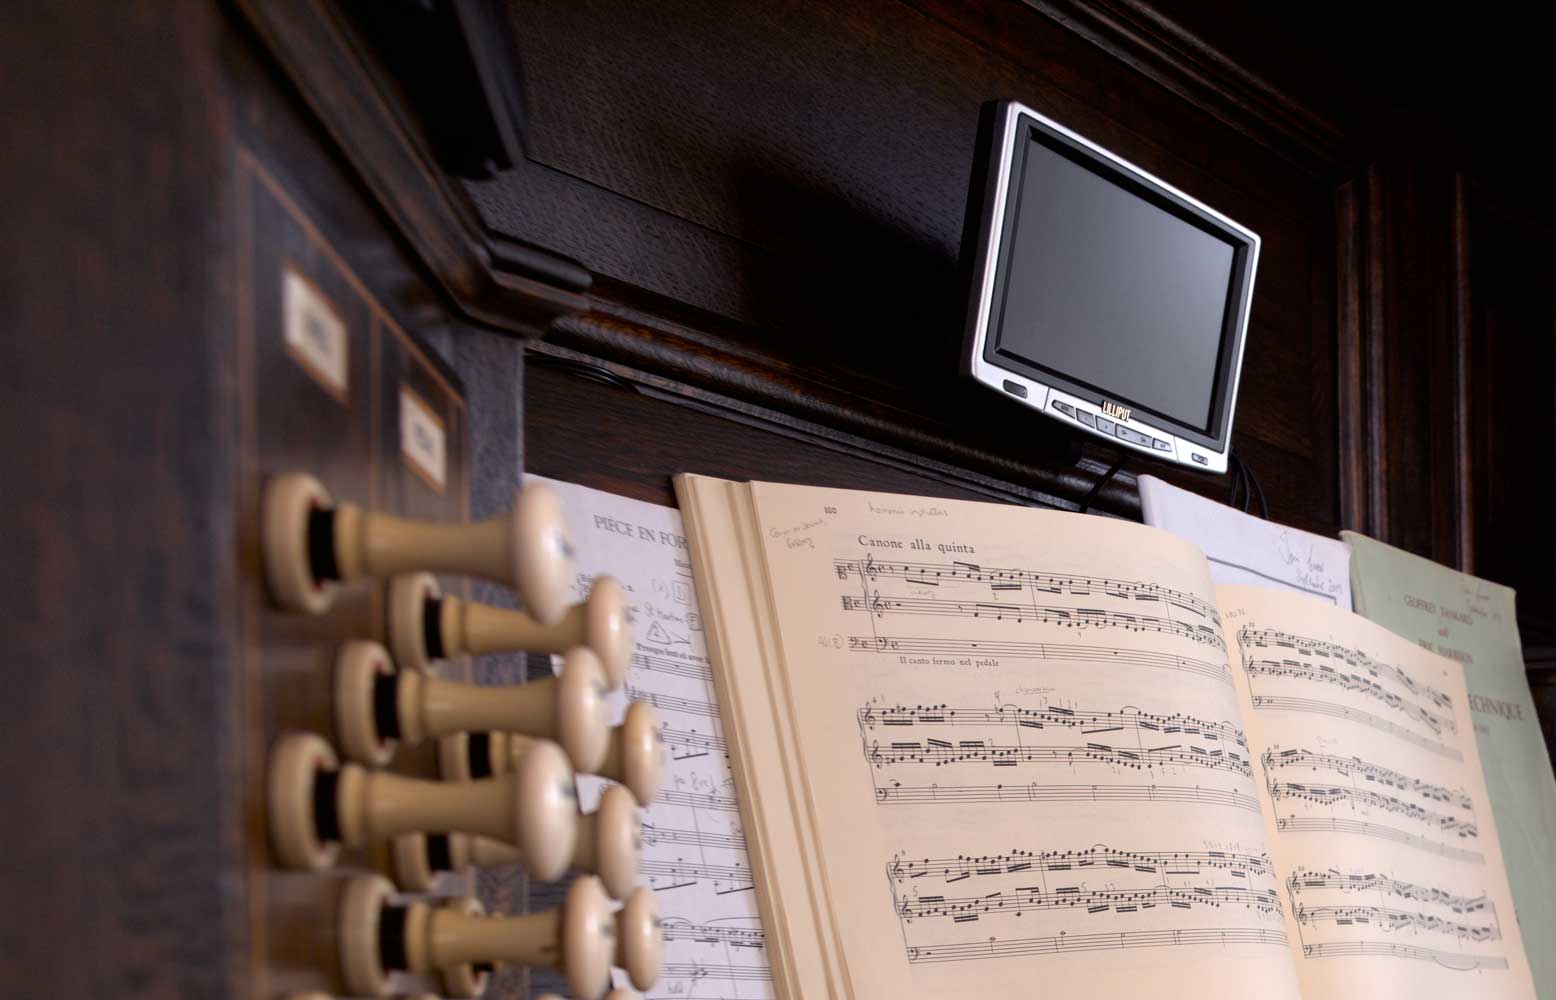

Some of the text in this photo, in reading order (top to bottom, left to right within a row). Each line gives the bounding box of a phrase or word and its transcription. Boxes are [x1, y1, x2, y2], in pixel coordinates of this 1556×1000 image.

[1102, 401, 1131, 422] LILLIPUT
[637, 526, 655, 542] EN
[858, 535, 975, 554] Canone alla quinta
[909, 657, 930, 665] canto
[932, 657, 955, 666] fermo
[960, 658, 972, 666] nel
[976, 659, 999, 668] pedale
